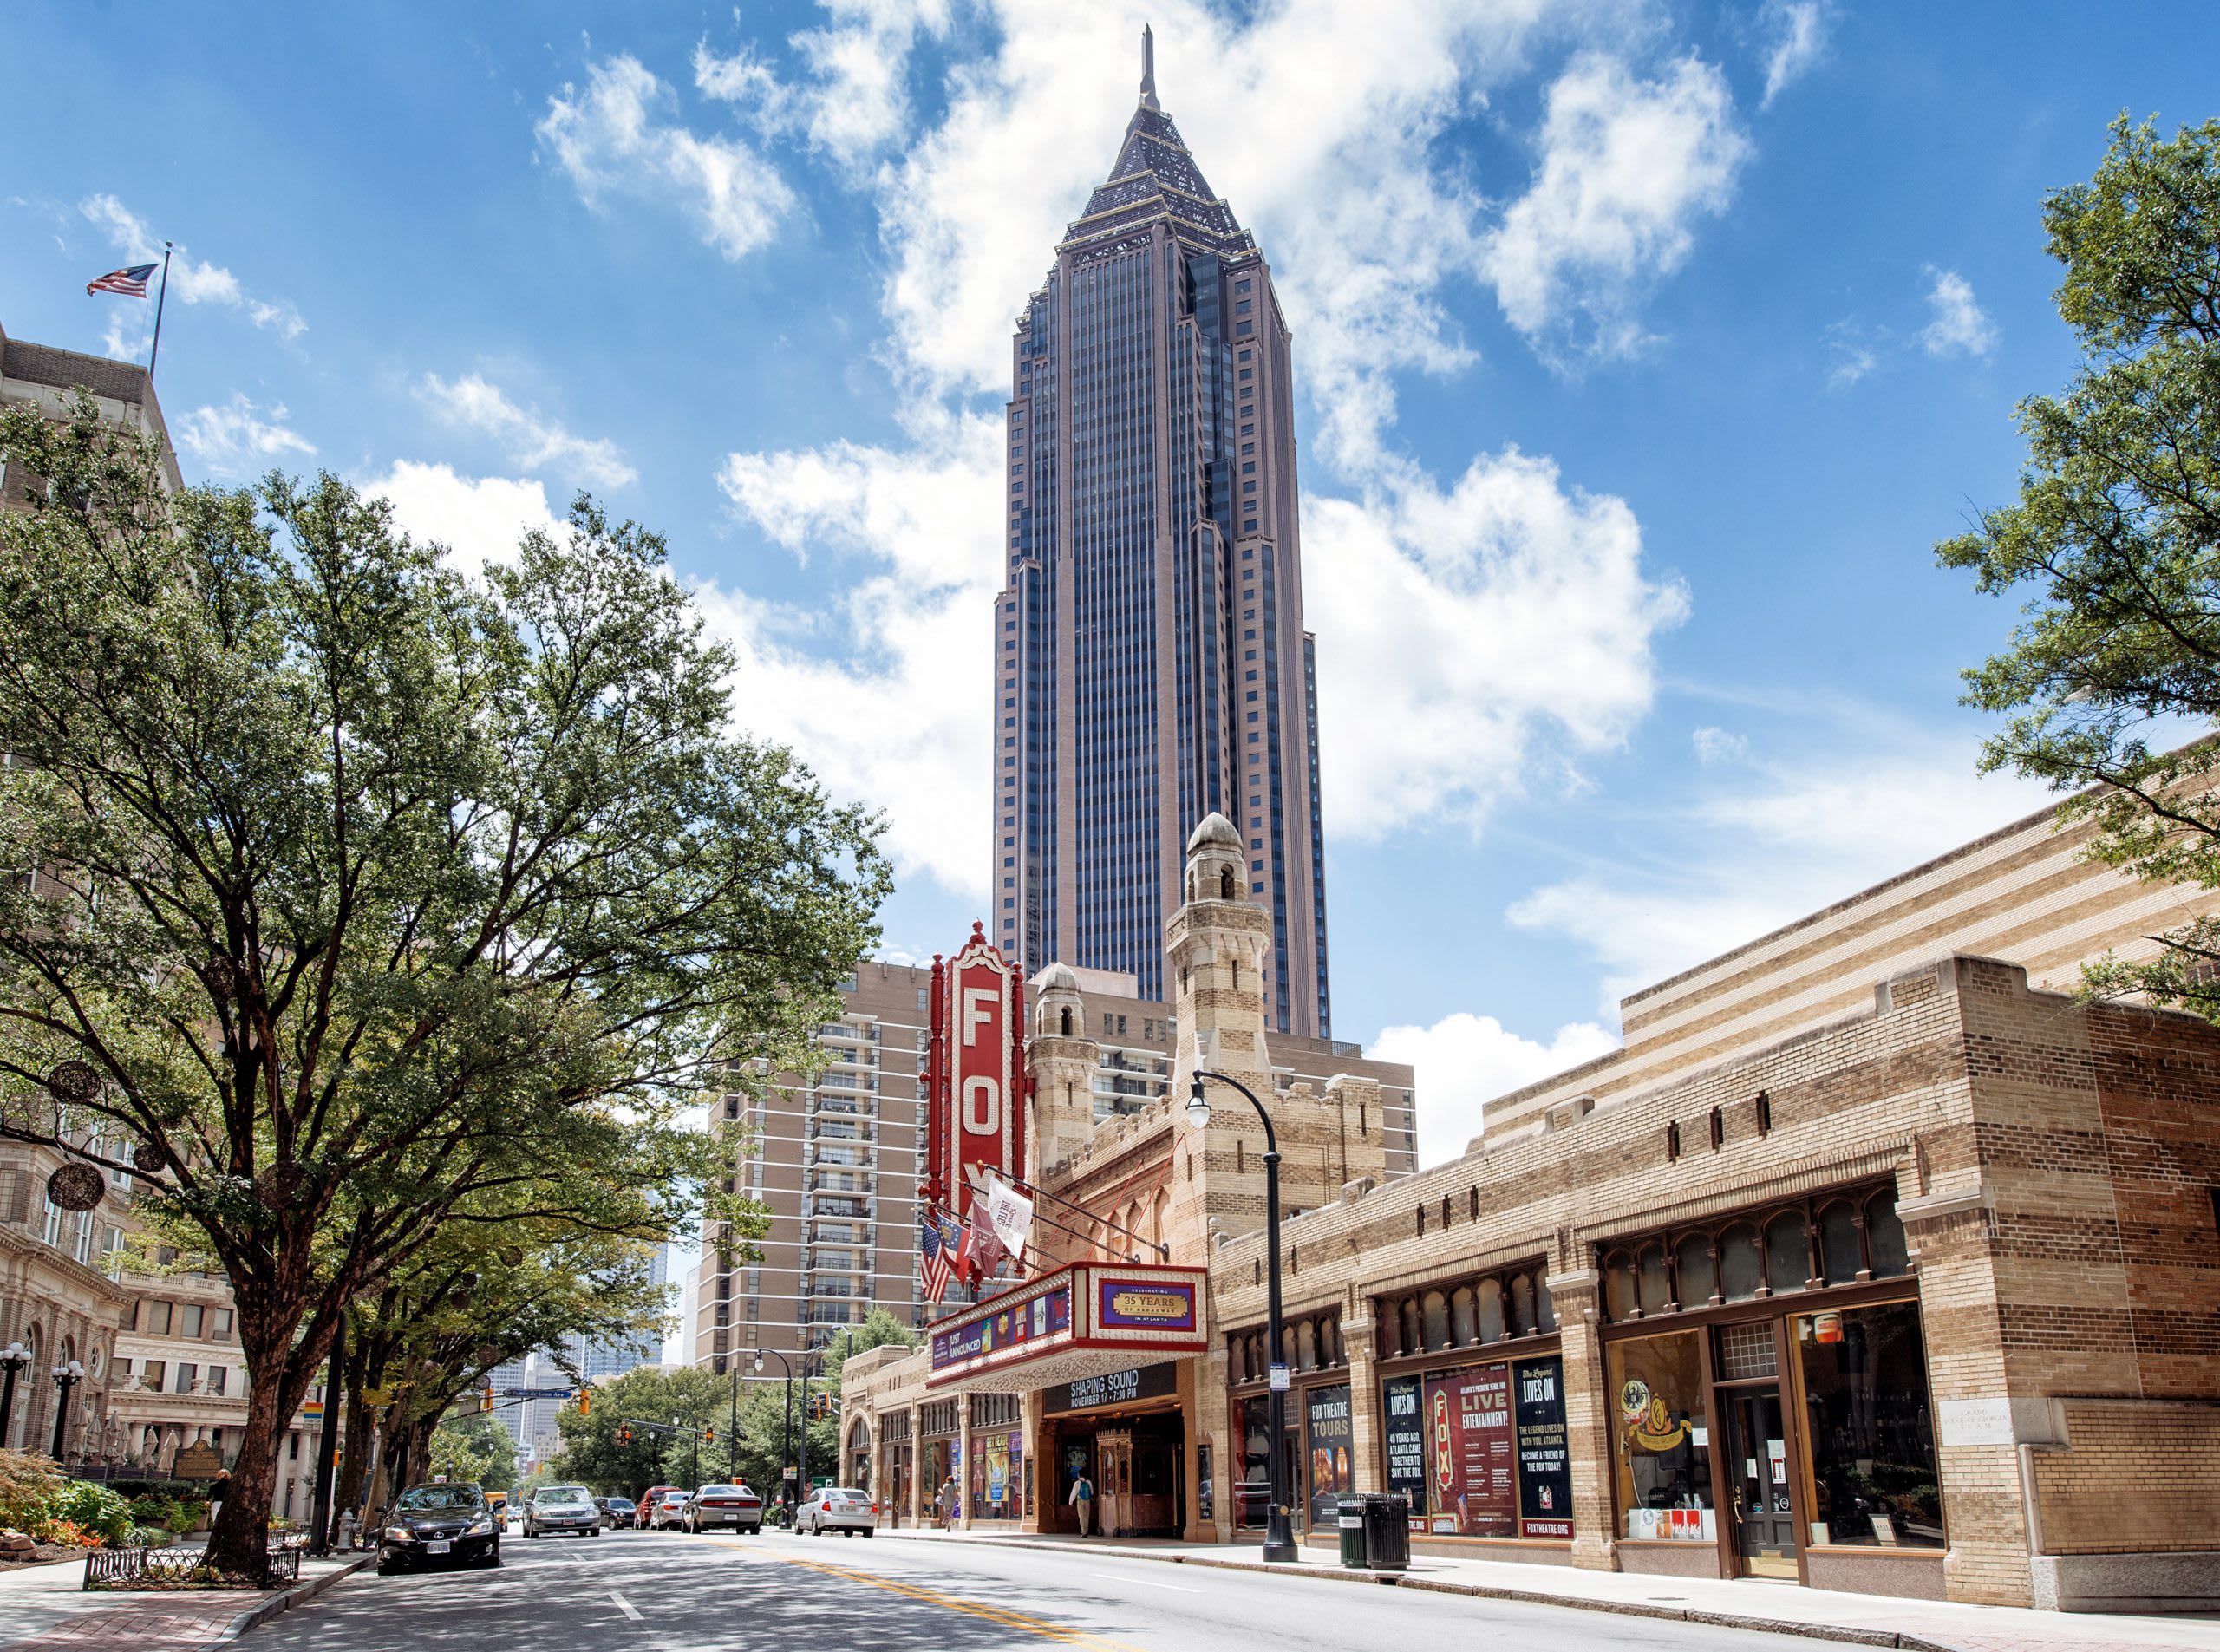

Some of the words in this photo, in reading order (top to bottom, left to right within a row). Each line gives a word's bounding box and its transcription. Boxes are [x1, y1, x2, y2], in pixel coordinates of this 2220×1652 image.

[1139, 1297, 1174, 1306] YEARS
[950, 1333, 960, 1348] JUST
[950, 1339, 980, 1359] ANNOUNCED
[1523, 1369, 1532, 1379] The
[1533, 1368, 1553, 1379] Legend
[1071, 1377, 1105, 1397] SHAPING
[1108, 1370, 1138, 1390] SOUND
[1523, 1379, 1543, 1403] LIVES
[1544, 1378, 1554, 1401] ON
[1071, 1394, 1100, 1407] NOVEMBER
[1101, 1393, 1107, 1403] 17
[1113, 1390, 1125, 1401] 7:30
[1127, 1388, 1136, 1398] PM
[1461, 1392, 1507, 1411] LIVE
[1312, 1405, 1322, 1420] FOX
[1323, 1401, 1348, 1419] THEATRE
[1391, 1395, 1407, 1415] LIVES
[1407, 1394, 1415, 1414] ON
[1462, 1410, 1508, 1429] ENTERTAINMENT!
[1313, 1420, 1348, 1437] TOURS
[1519, 1426, 1528, 1434] THE
[1528, 1425, 1544, 1434] LEGEND
[1544, 1424, 1557, 1433] LIVES
[1557, 1423, 1564, 1433] ON
[1389, 1433, 1395, 1443] 40
[1396, 1433, 1409, 1443] YEARS
[1437, 1401, 1450, 1473] FOX
[1521, 1437, 1532, 1446] WITH
[1544, 1435, 1564, 1445] ATLANTA.
[1390, 1444, 1408, 1455] ATLANTA
[1409, 1443, 1421, 1454] CAME
[1521, 1451, 1539, 1460] BECOME
[1539, 1451, 1543, 1459] A
[1543, 1450, 1559, 1459] FRIEND
[1559, 1450, 1565, 1459] OF
[1392, 1455, 1414, 1466] TOGETHER
[1414, 1455, 1420, 1466] TO
[1527, 1462, 1536, 1472] THE
[1536, 1462, 1545, 1471] FOX
[1545, 1461, 1561, 1471] TODAY!
[1391, 1467, 1402, 1478] SAVE
[1412, 1467, 1422, 1478] FOX.
[1527, 1523, 1568, 1535] FOXTHEATRE.ORG
